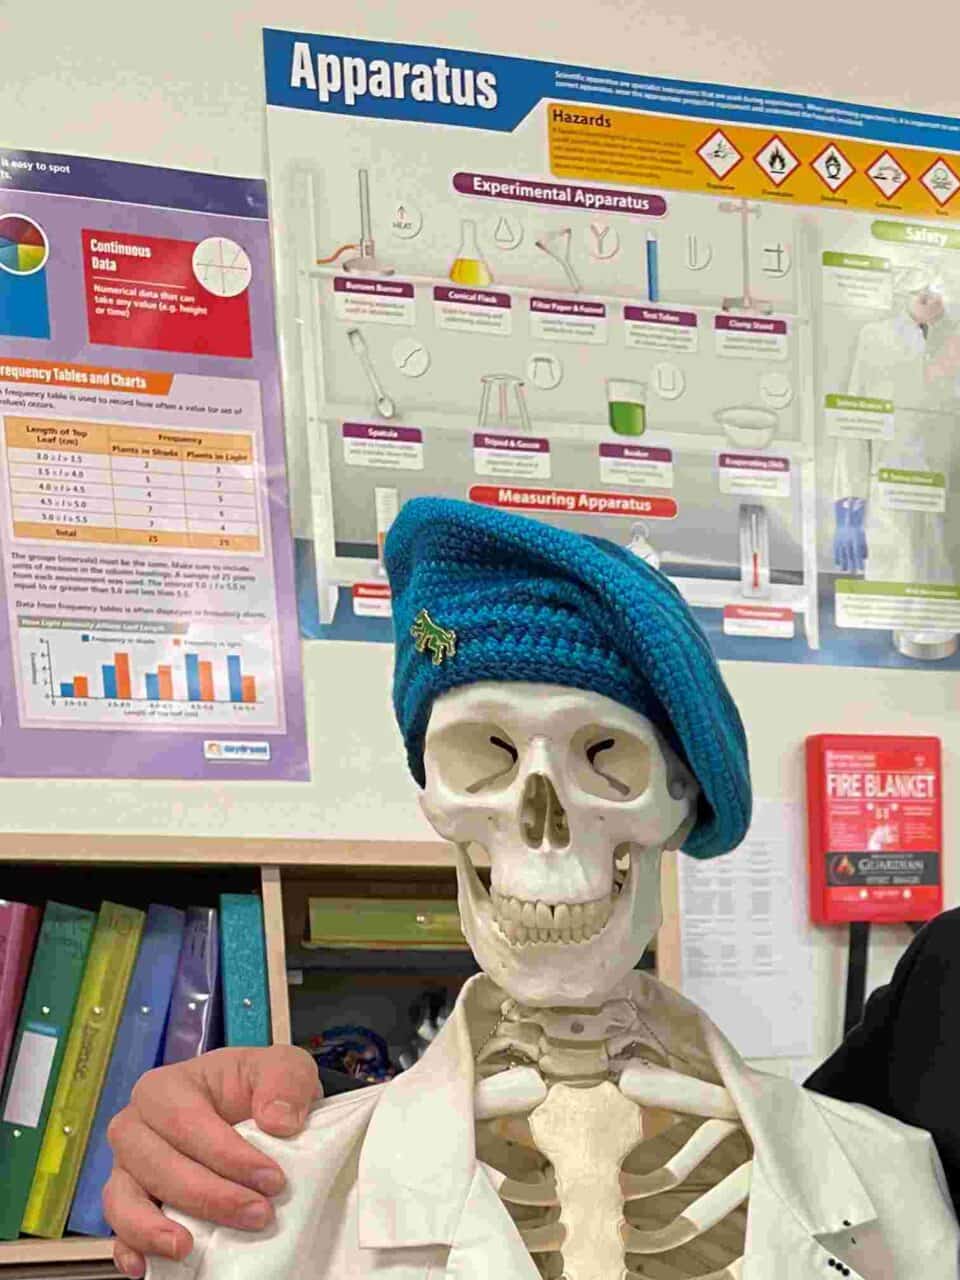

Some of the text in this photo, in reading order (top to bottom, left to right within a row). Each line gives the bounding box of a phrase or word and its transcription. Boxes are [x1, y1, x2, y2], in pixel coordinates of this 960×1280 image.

[291, 42, 498, 110] Apparatus
[552, 109, 612, 128] Hazards
[36, 162, 47, 171] to
[49, 164, 71, 173] spot
[473, 177, 649, 210] Experimental Apparatus
[905, 228, 948, 246] Safety
[90, 238, 152, 258] Continuous
[91, 256, 117, 271] Data
[53, 367, 88, 384] Tables
[89, 372, 110, 386] and
[111, 373, 147, 388] Charts
[498, 489, 651, 512] Measuring Apparatus
[827, 774, 936, 798] FIRE BLANKET
